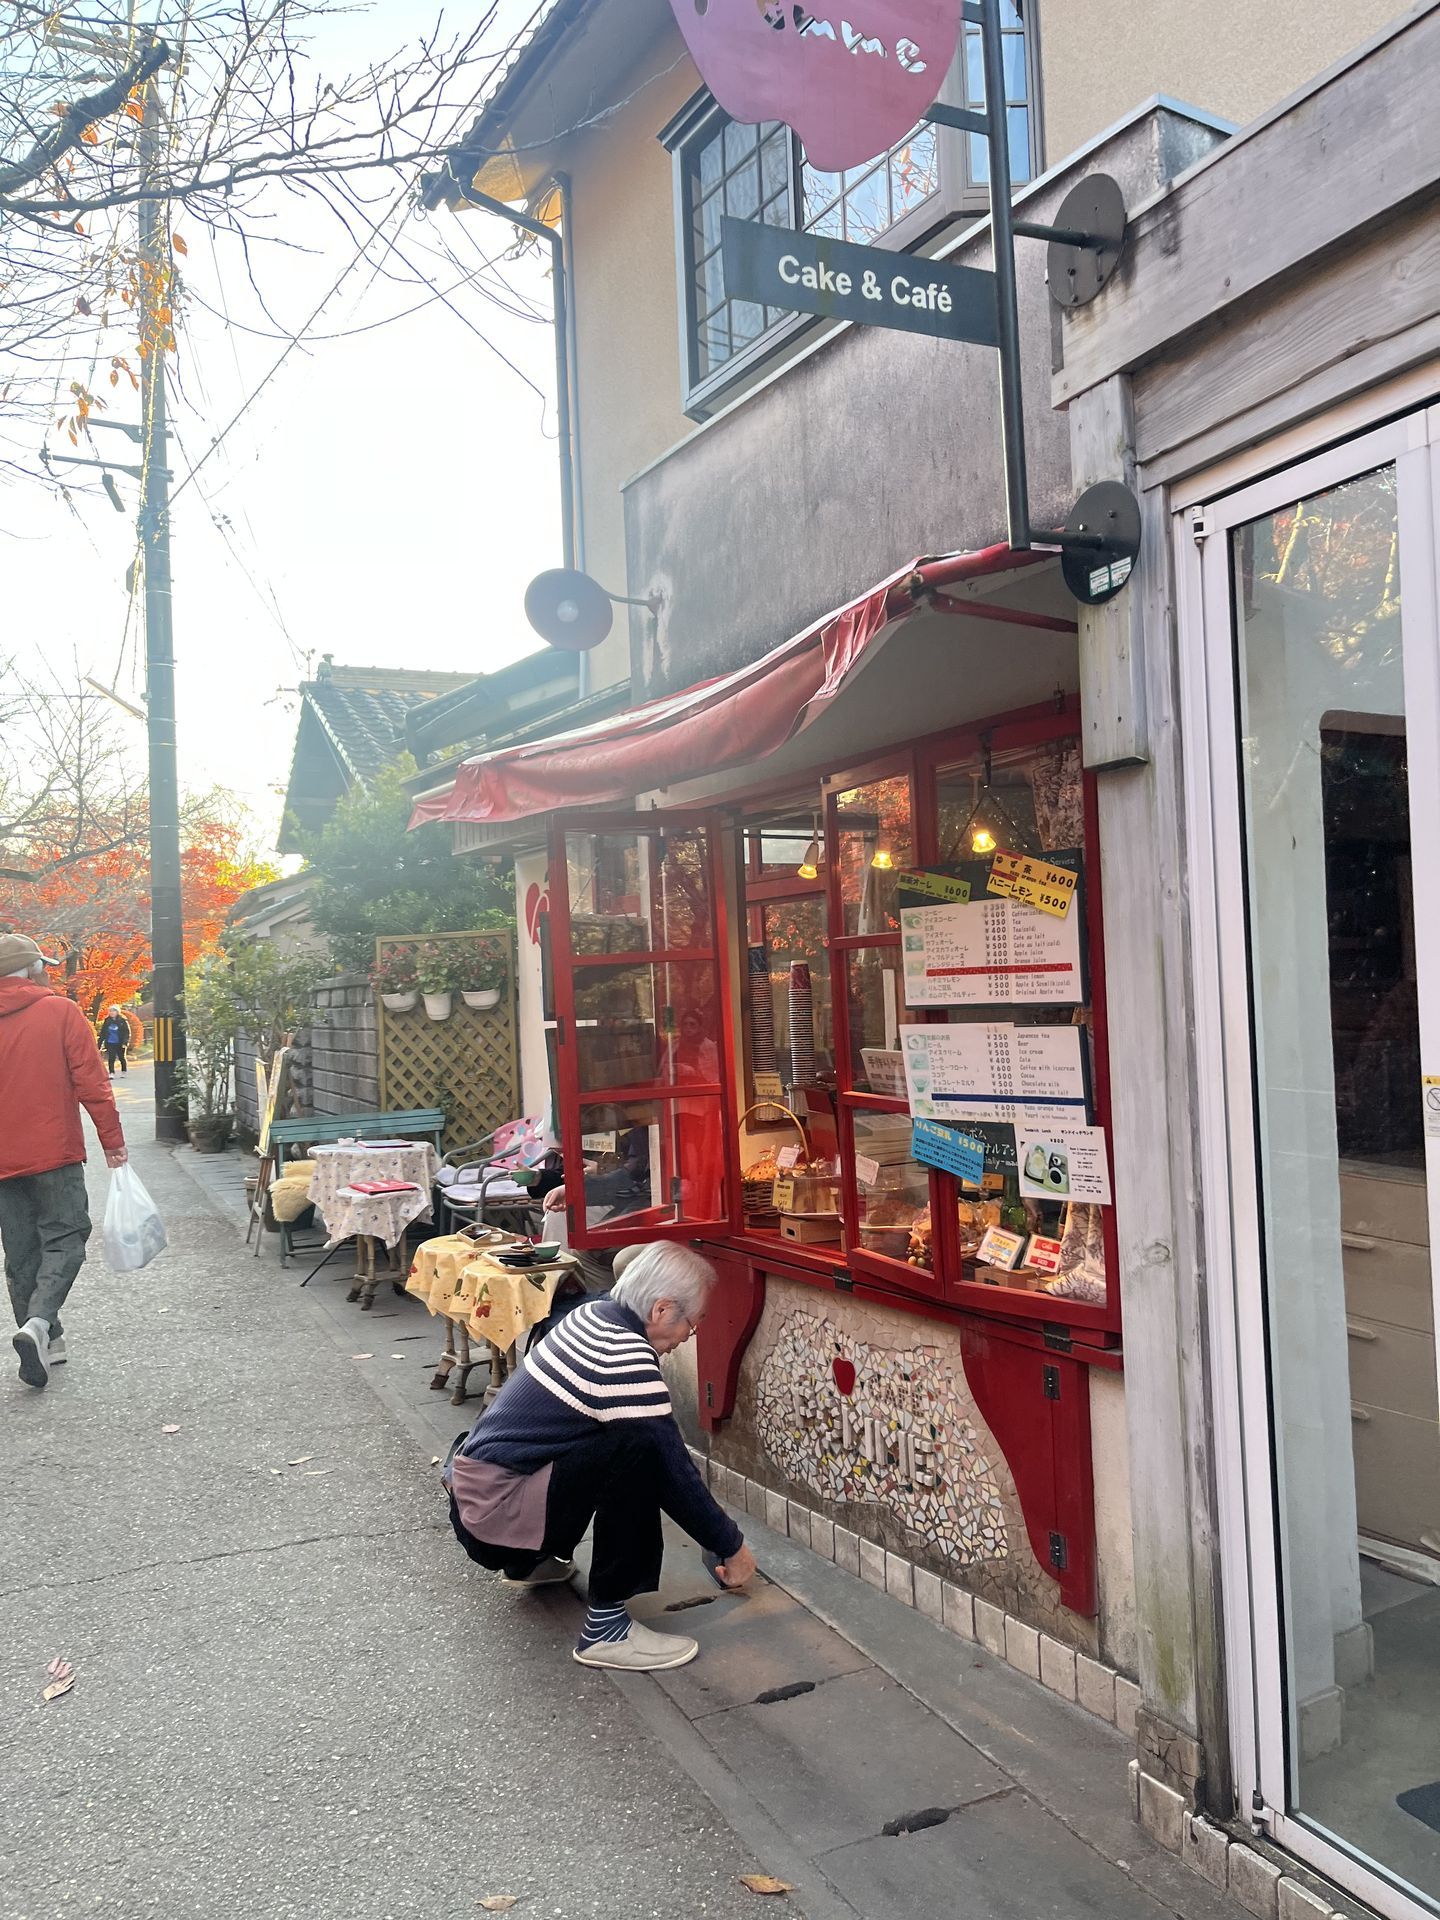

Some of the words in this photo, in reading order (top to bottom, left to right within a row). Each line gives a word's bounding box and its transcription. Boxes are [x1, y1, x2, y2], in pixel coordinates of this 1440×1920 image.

[778, 255, 852, 295] Cake
[861, 270, 883, 301] &
[891, 276, 952, 313] Café
[990, 876, 1033, 897] ハニーレモン
[1040, 894, 1067, 910] ¥500
[1046, 872, 1073, 888] ¥600
